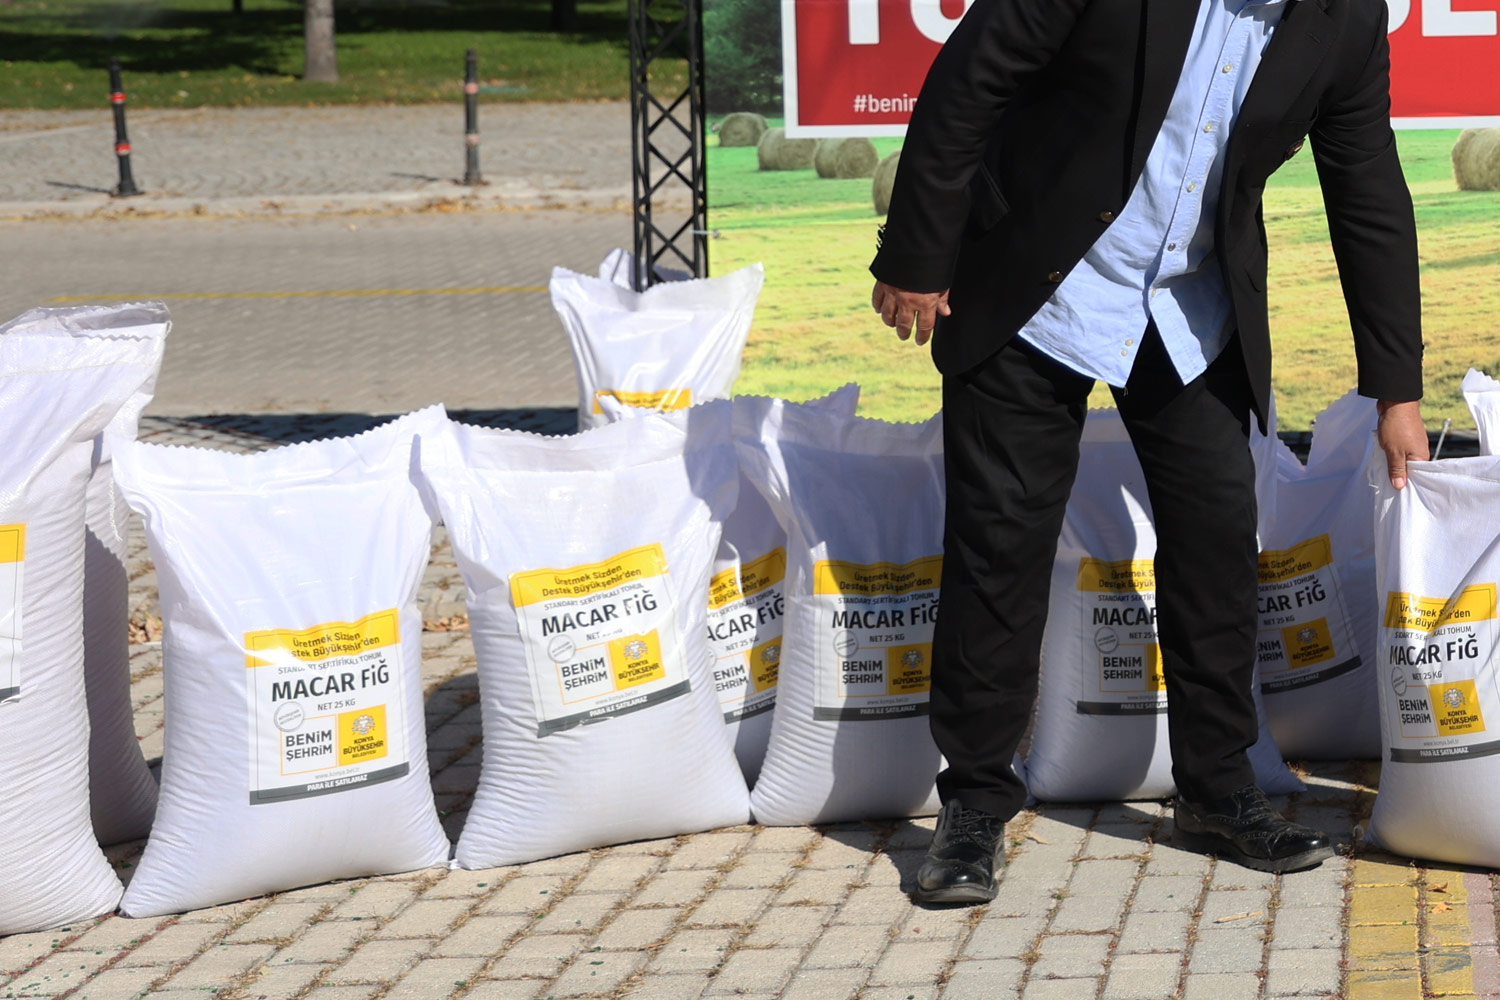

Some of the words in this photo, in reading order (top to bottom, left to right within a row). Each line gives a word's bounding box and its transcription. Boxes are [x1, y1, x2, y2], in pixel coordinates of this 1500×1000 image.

[1271, 557, 1295, 568] Sizden
[555, 574, 591, 585] Üretmek
[593, 566, 622, 579] Sizden
[542, 587, 572, 597] Destek
[1258, 595, 1291, 613] CAR
[542, 604, 618, 636] MACAR
[832, 610, 904, 629] MACAR
[1448, 626, 1471, 634] TOHUM
[293, 634, 332, 647] Üretmek
[586, 632, 600, 641] NET
[870, 635, 883, 643] NET
[359, 652, 381, 662] TOHUM
[1433, 671, 1442, 679] KG
[272, 672, 355, 701] MACAR
[318, 702, 332, 711] NET
[334, 701, 343, 709] 25
[346, 699, 356, 707] KG
[307, 783, 324, 791] PARA
